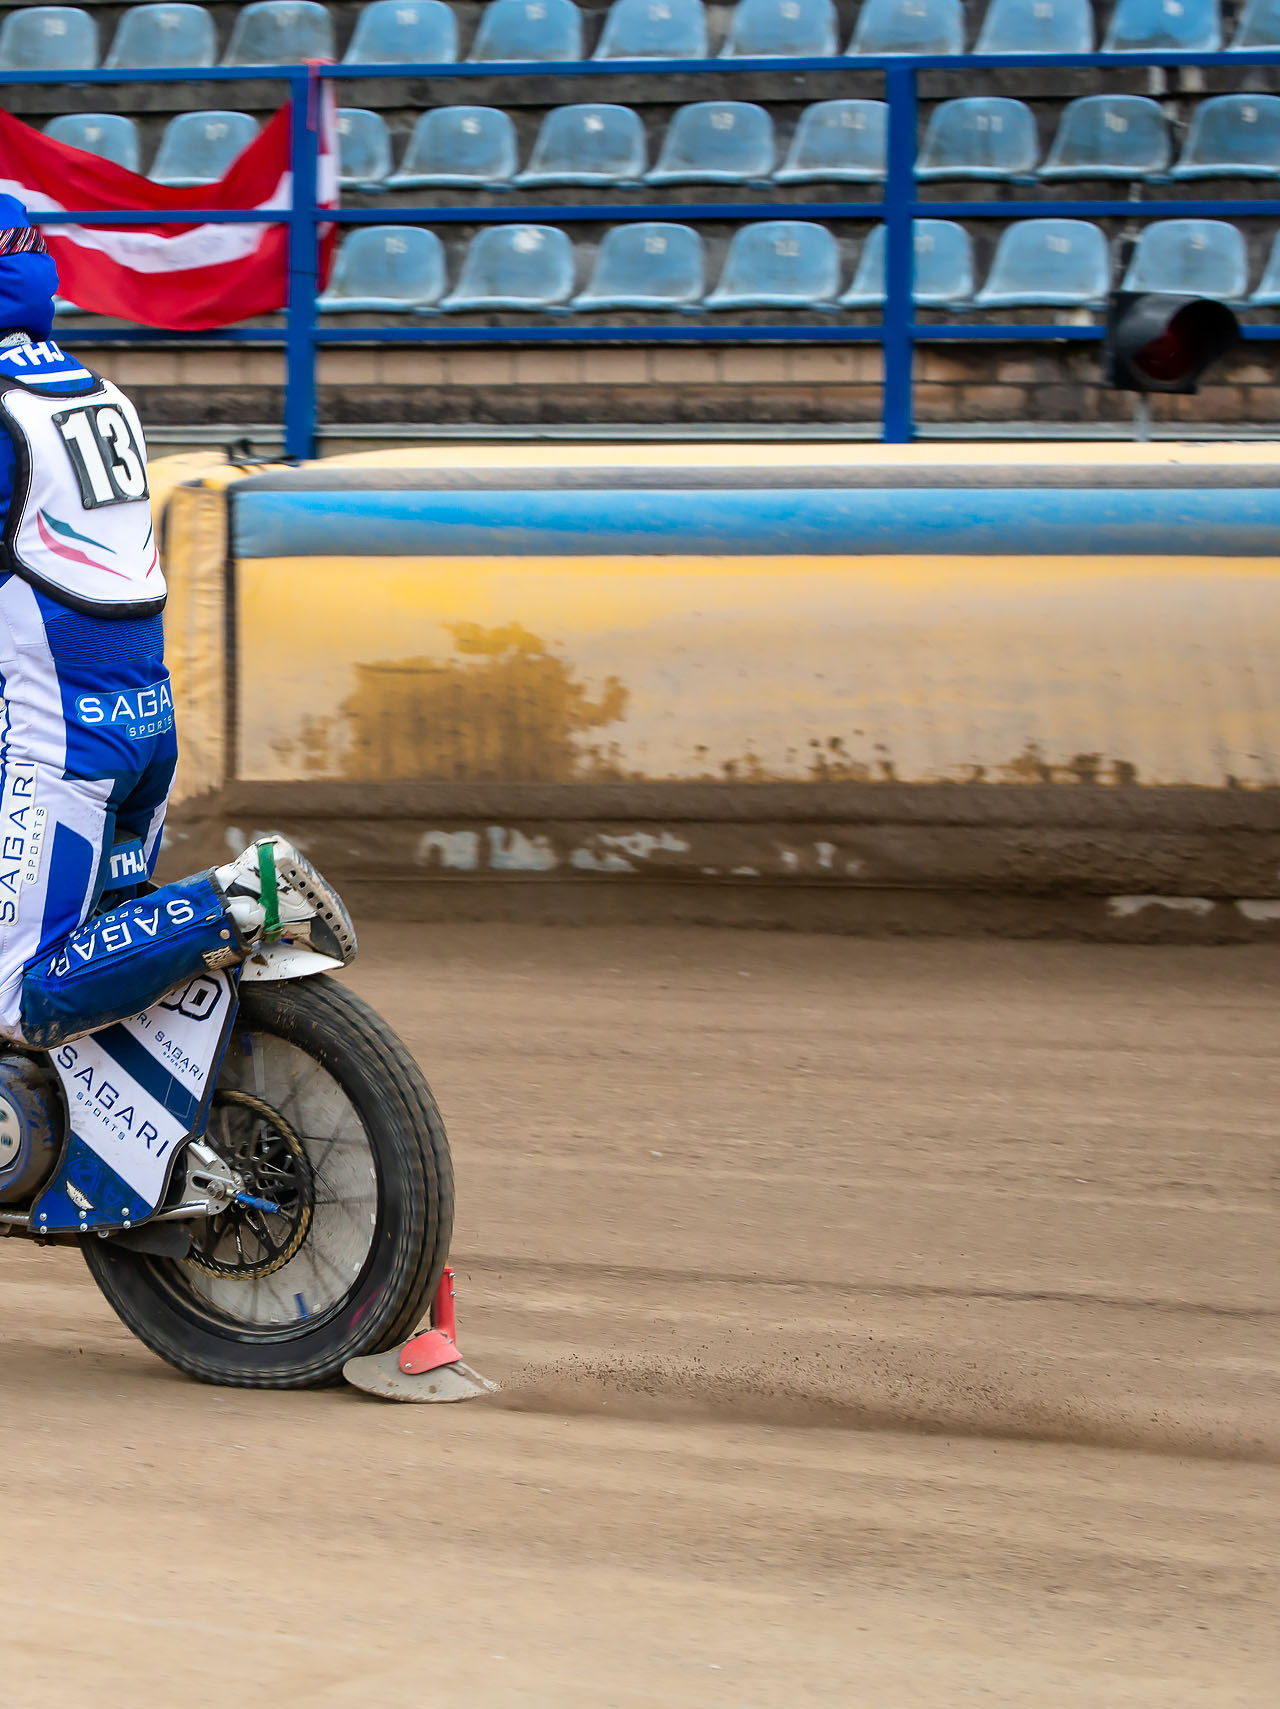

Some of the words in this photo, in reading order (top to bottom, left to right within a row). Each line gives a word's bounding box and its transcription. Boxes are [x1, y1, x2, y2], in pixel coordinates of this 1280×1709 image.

[61, 407, 146, 503] 13
[79, 685, 175, 723] SAGA
[25, 808, 46, 882] SPORTS
[109, 848, 146, 879] THJ
[154, 1030, 205, 1081] SAGARI
[57, 1045, 170, 1158] SAGARI
[76, 1091, 126, 1141] SPORTS
